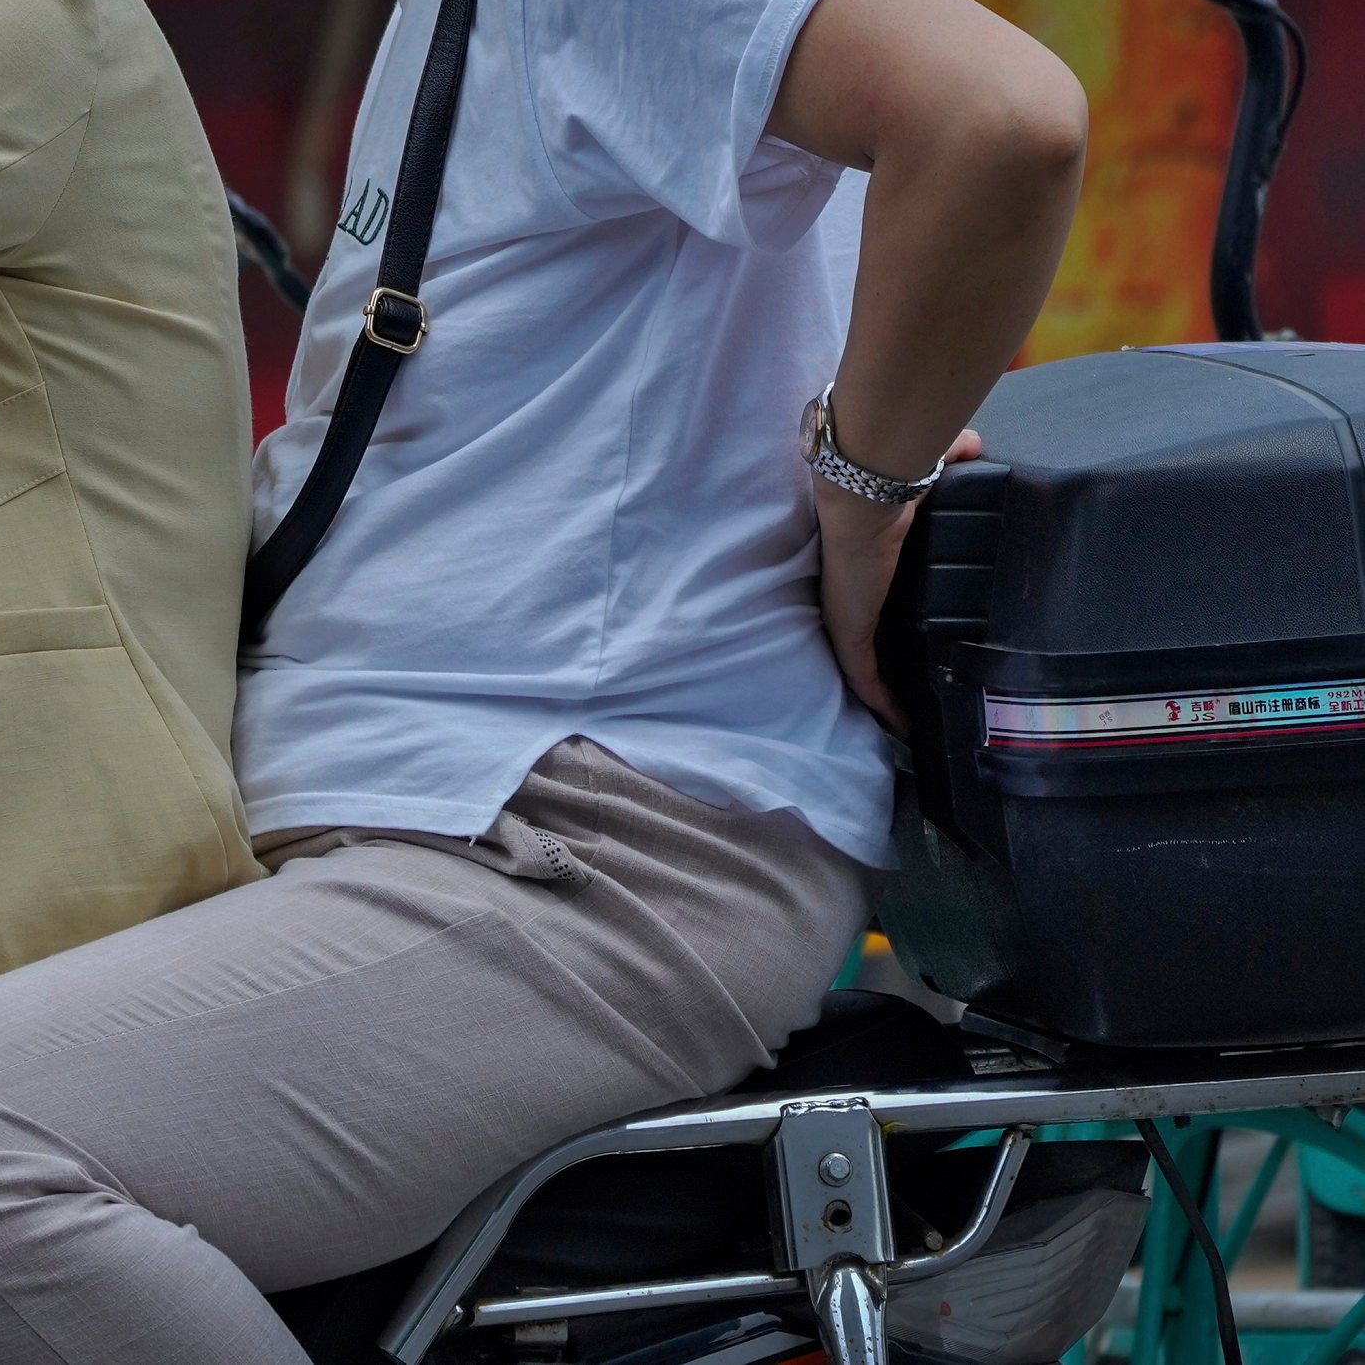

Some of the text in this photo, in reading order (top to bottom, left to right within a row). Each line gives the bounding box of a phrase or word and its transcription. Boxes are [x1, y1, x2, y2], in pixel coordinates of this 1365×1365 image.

[1327, 689, 1365, 700] 982M
[1191, 700, 1215, 713] 吉顺
[1228, 696, 1321, 716] 眉山市注册商标
[1191, 712, 1215, 722] JS
